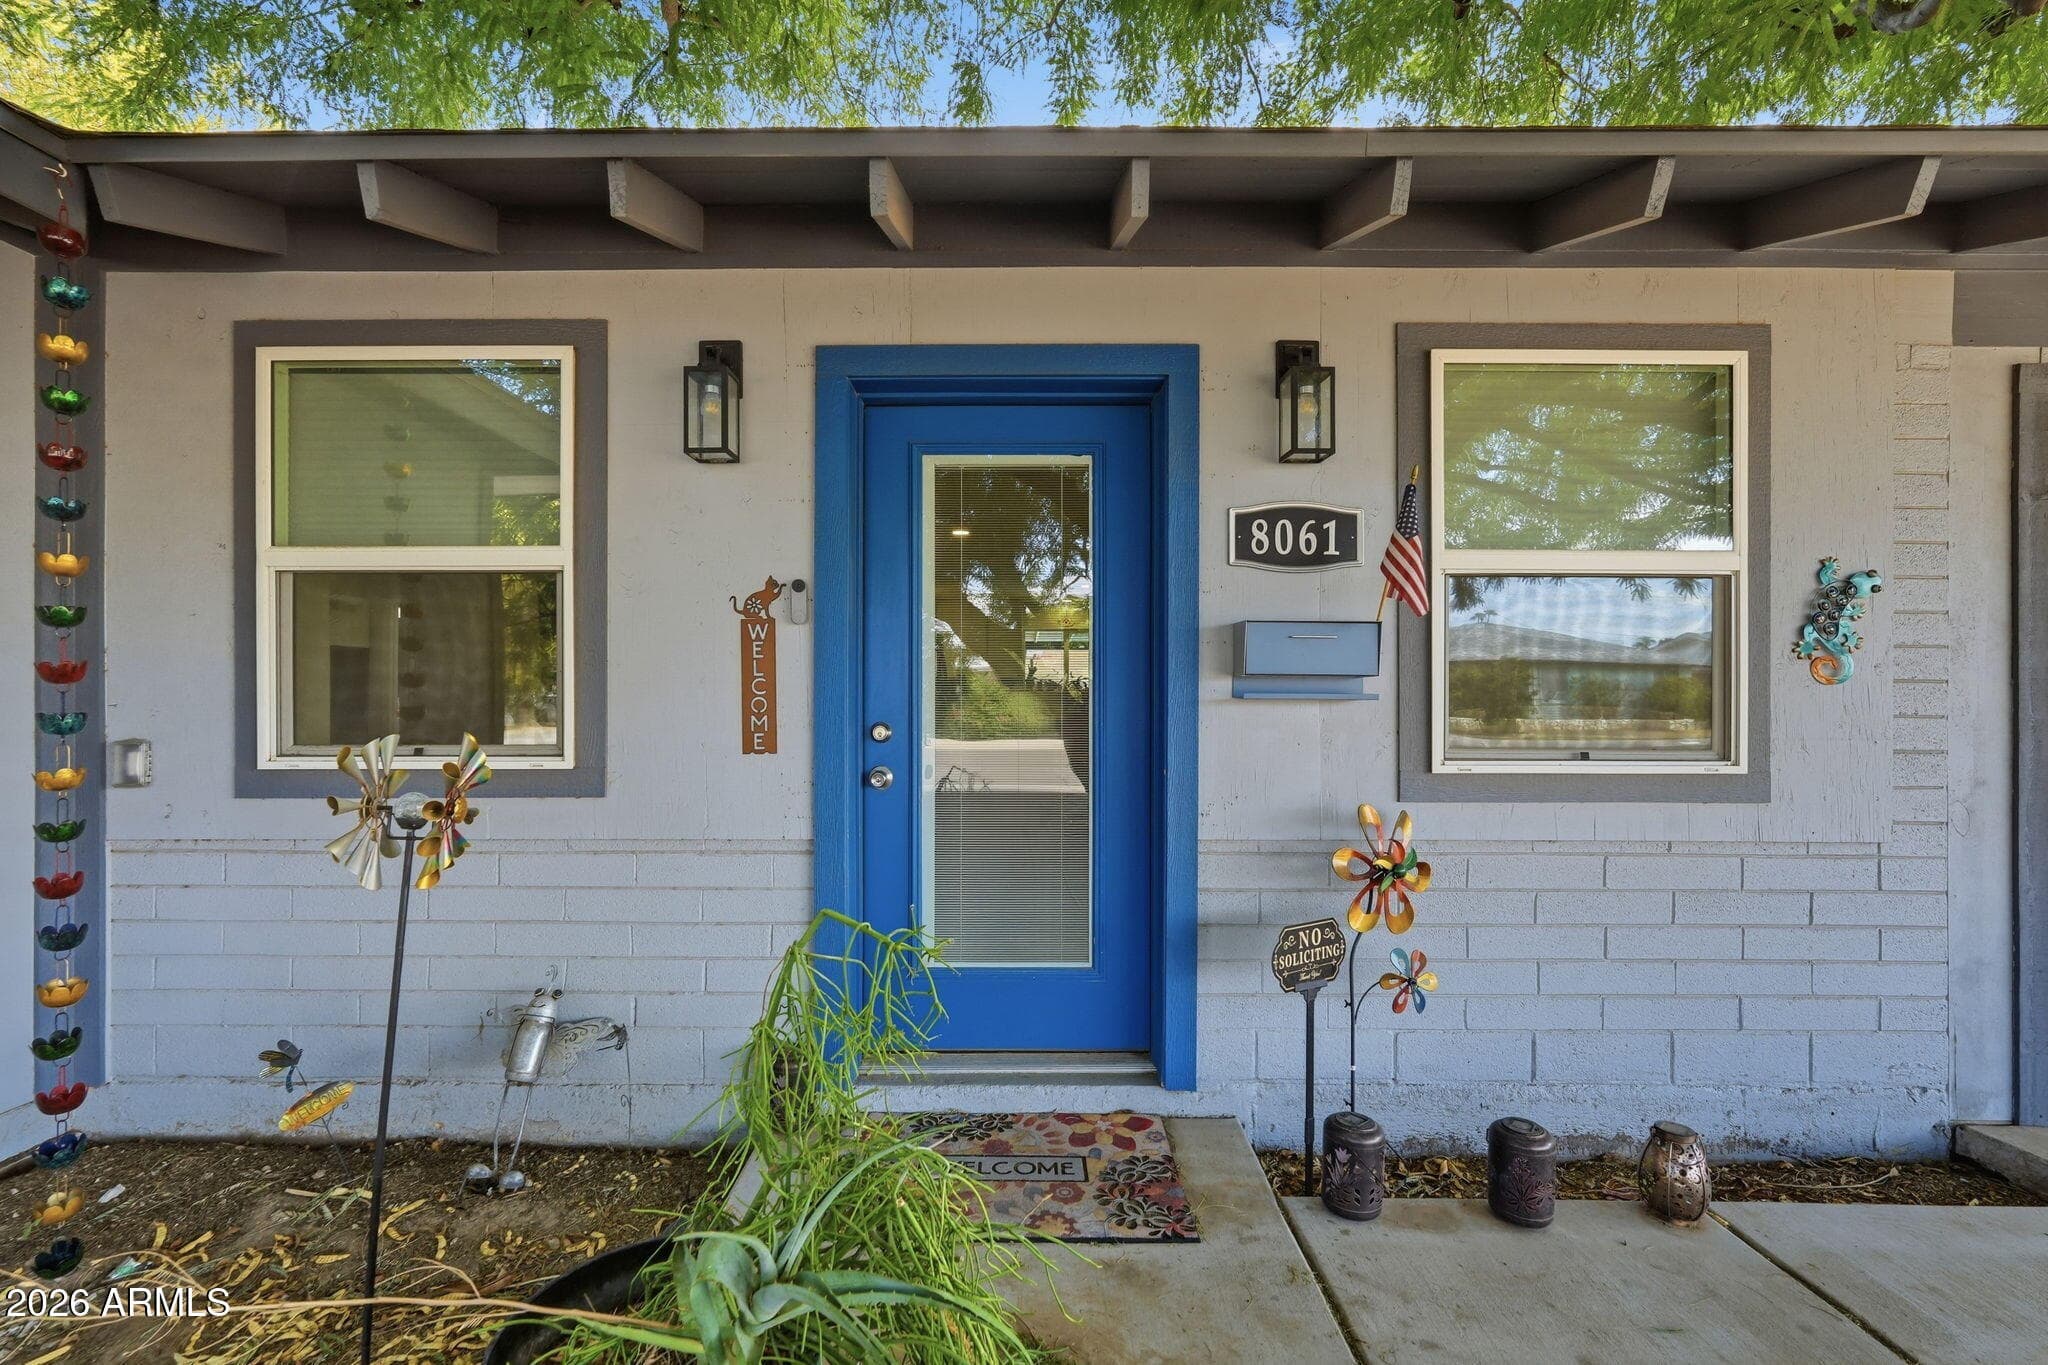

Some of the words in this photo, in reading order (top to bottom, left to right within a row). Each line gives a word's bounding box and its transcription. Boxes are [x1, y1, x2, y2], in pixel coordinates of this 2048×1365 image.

[1251, 518, 1340, 555] 8061
[747, 623, 769, 750] WELCOME
[1298, 927, 1322, 949] NO
[1279, 943, 1340, 970] SOLICITING
